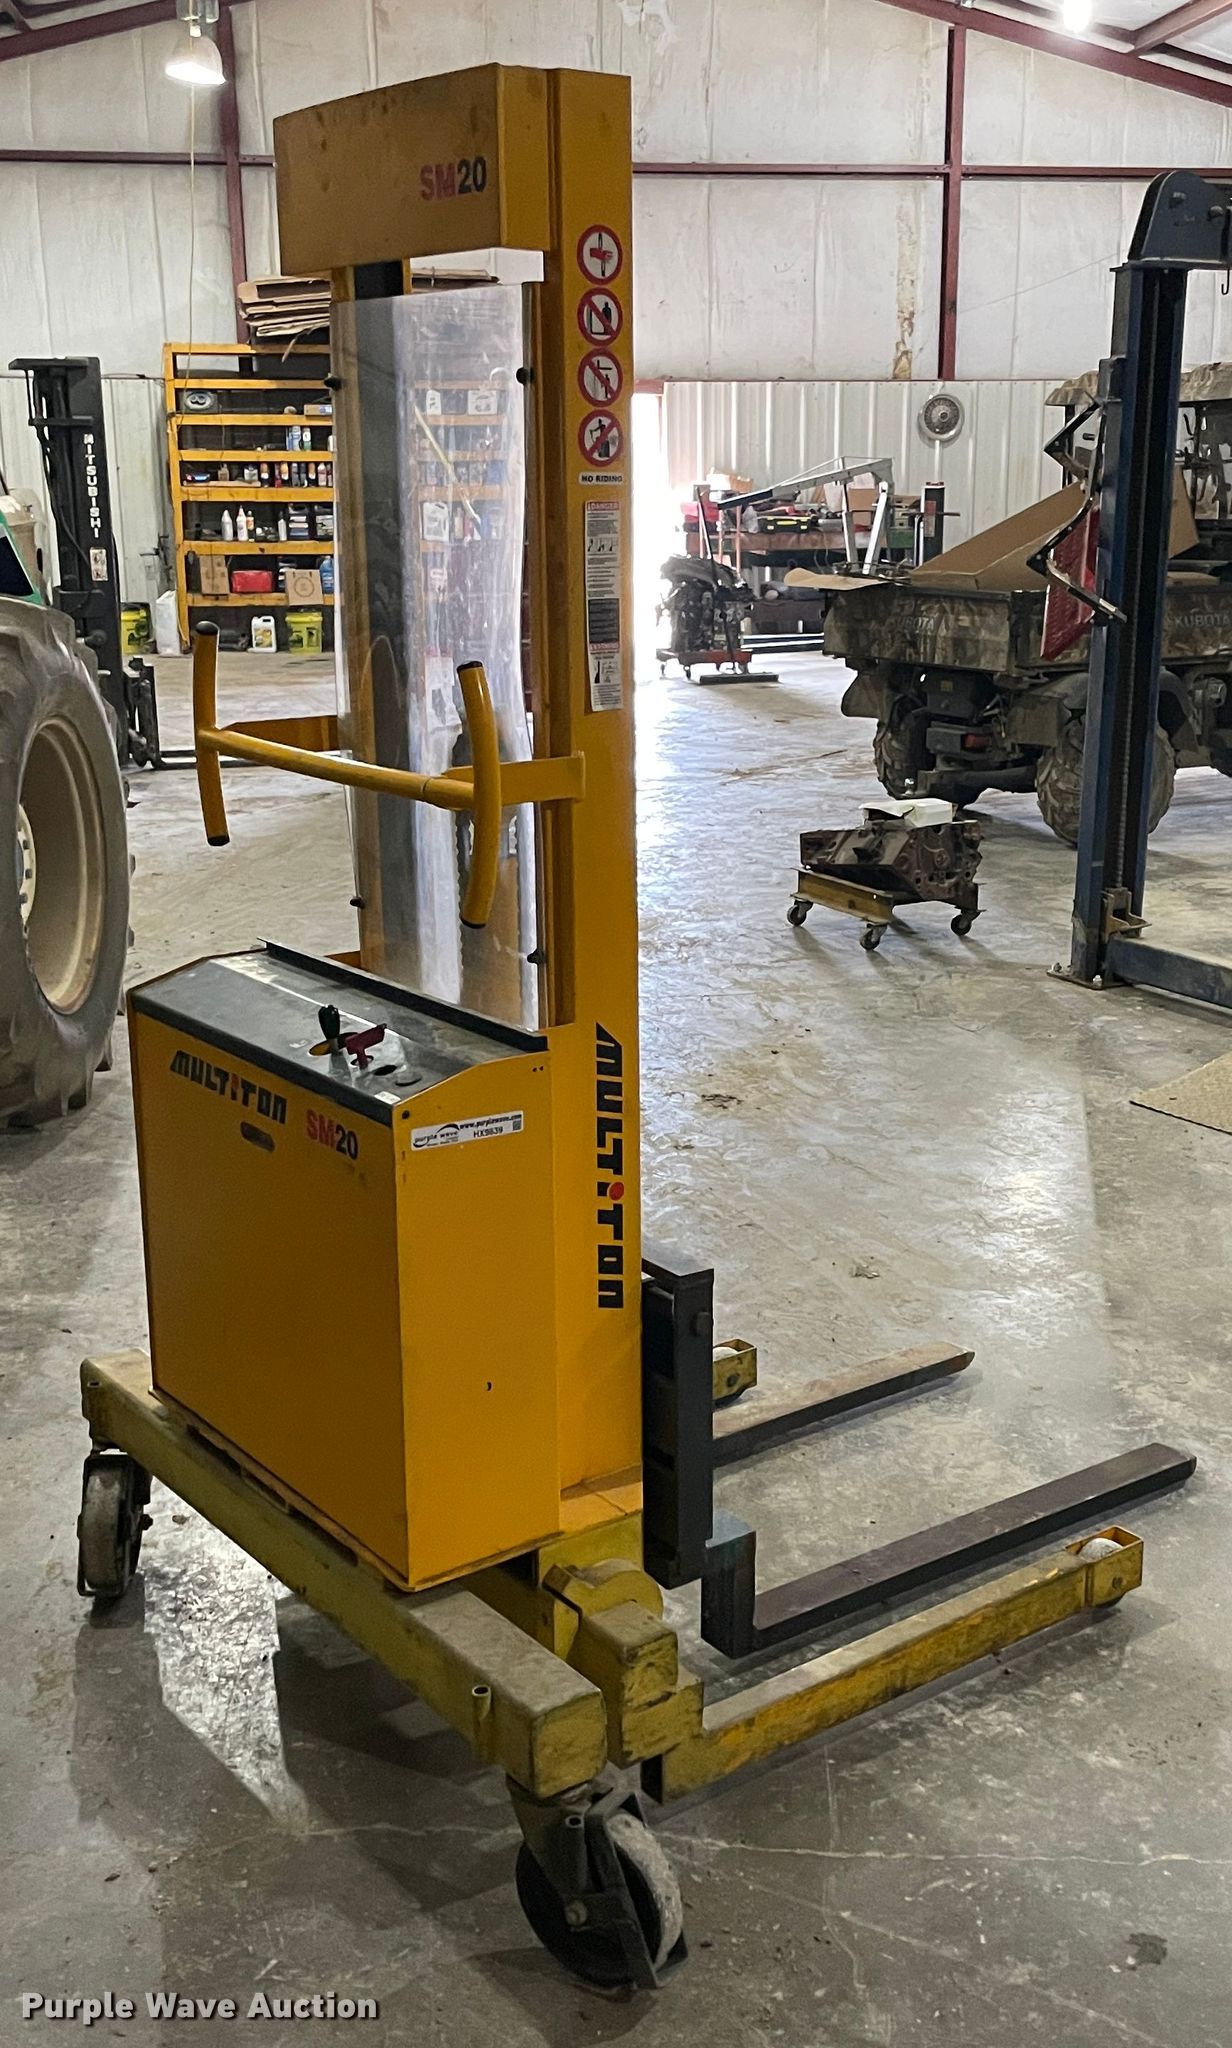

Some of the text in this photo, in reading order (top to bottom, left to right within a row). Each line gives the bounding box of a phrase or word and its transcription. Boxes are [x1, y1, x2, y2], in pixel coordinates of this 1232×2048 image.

[420, 155, 487, 201] SM20
[83, 433, 101, 538] MITSUBISHI
[581, 475, 623, 483] NO RIDING
[306, 1109, 359, 1161] SM20
